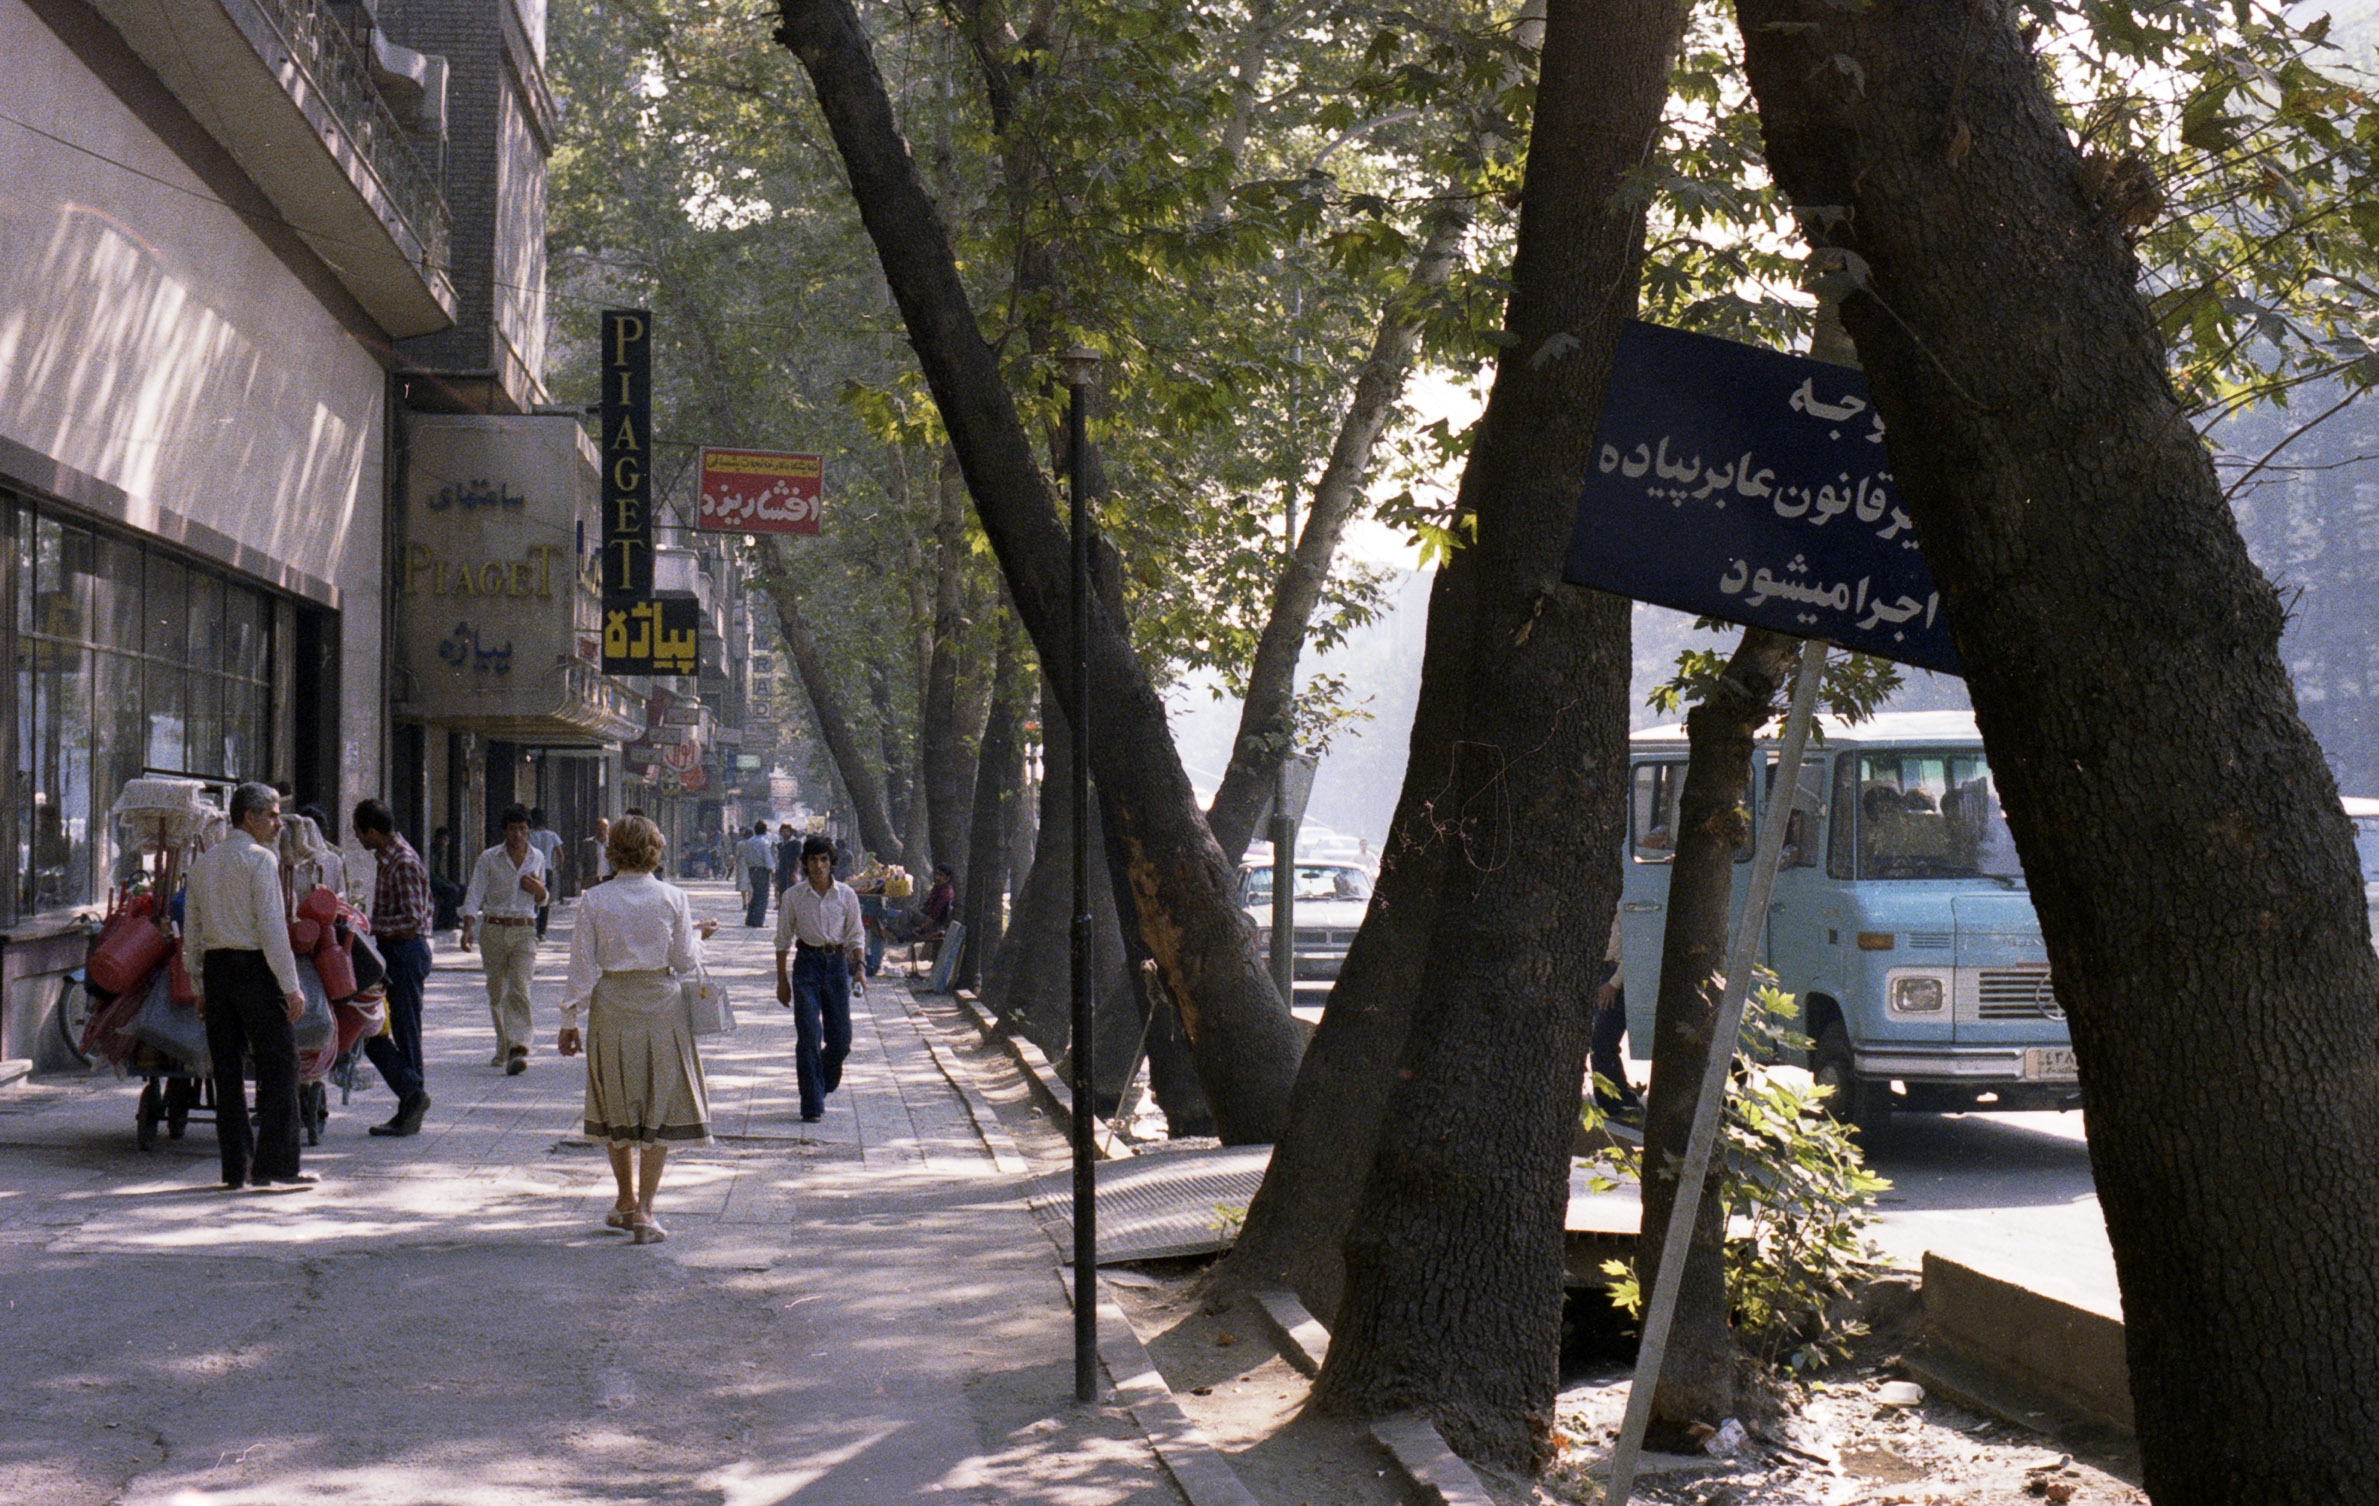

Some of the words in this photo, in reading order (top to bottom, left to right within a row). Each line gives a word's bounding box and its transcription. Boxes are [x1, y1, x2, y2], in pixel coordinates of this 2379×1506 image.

[1788, 377, 1887, 444] وجه
[608, 315, 649, 590] PIAGET
[1599, 435, 1701, 508] پیاده
[1691, 450, 1776, 510] عابر
[701, 484, 743, 525] یزد
[740, 480, 819, 522] افشار
[1772, 471, 1894, 526] قانون
[1876, 505, 1920, 550] یر
[403, 540, 563, 598] PIAGET
[604, 602, 696, 675] پیاژه
[1855, 575, 1940, 643] اجرا
[438, 620, 513, 678] پیاژه
